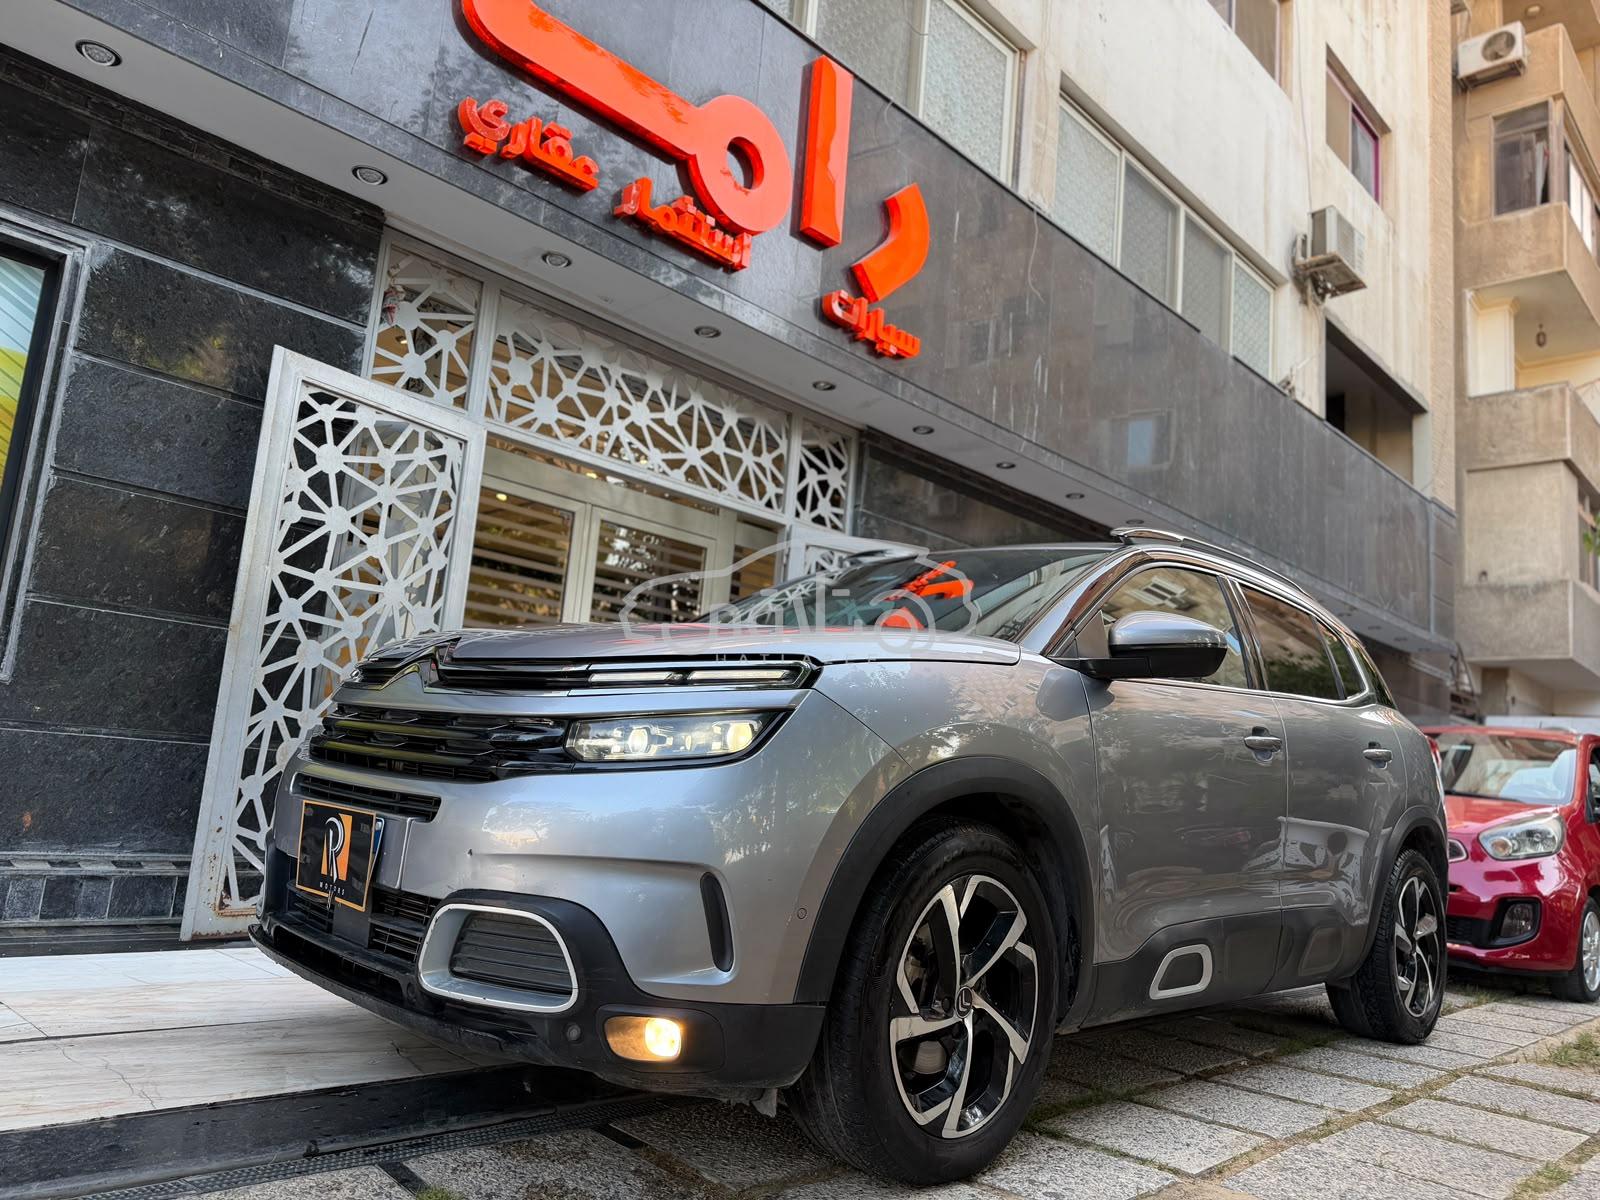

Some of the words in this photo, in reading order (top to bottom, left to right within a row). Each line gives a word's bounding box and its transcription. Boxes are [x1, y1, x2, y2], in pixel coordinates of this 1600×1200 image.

[458, 96, 599, 192] عقاري
[613, 177, 752, 271] استثمار
[822, 289, 921, 358] سيارات
